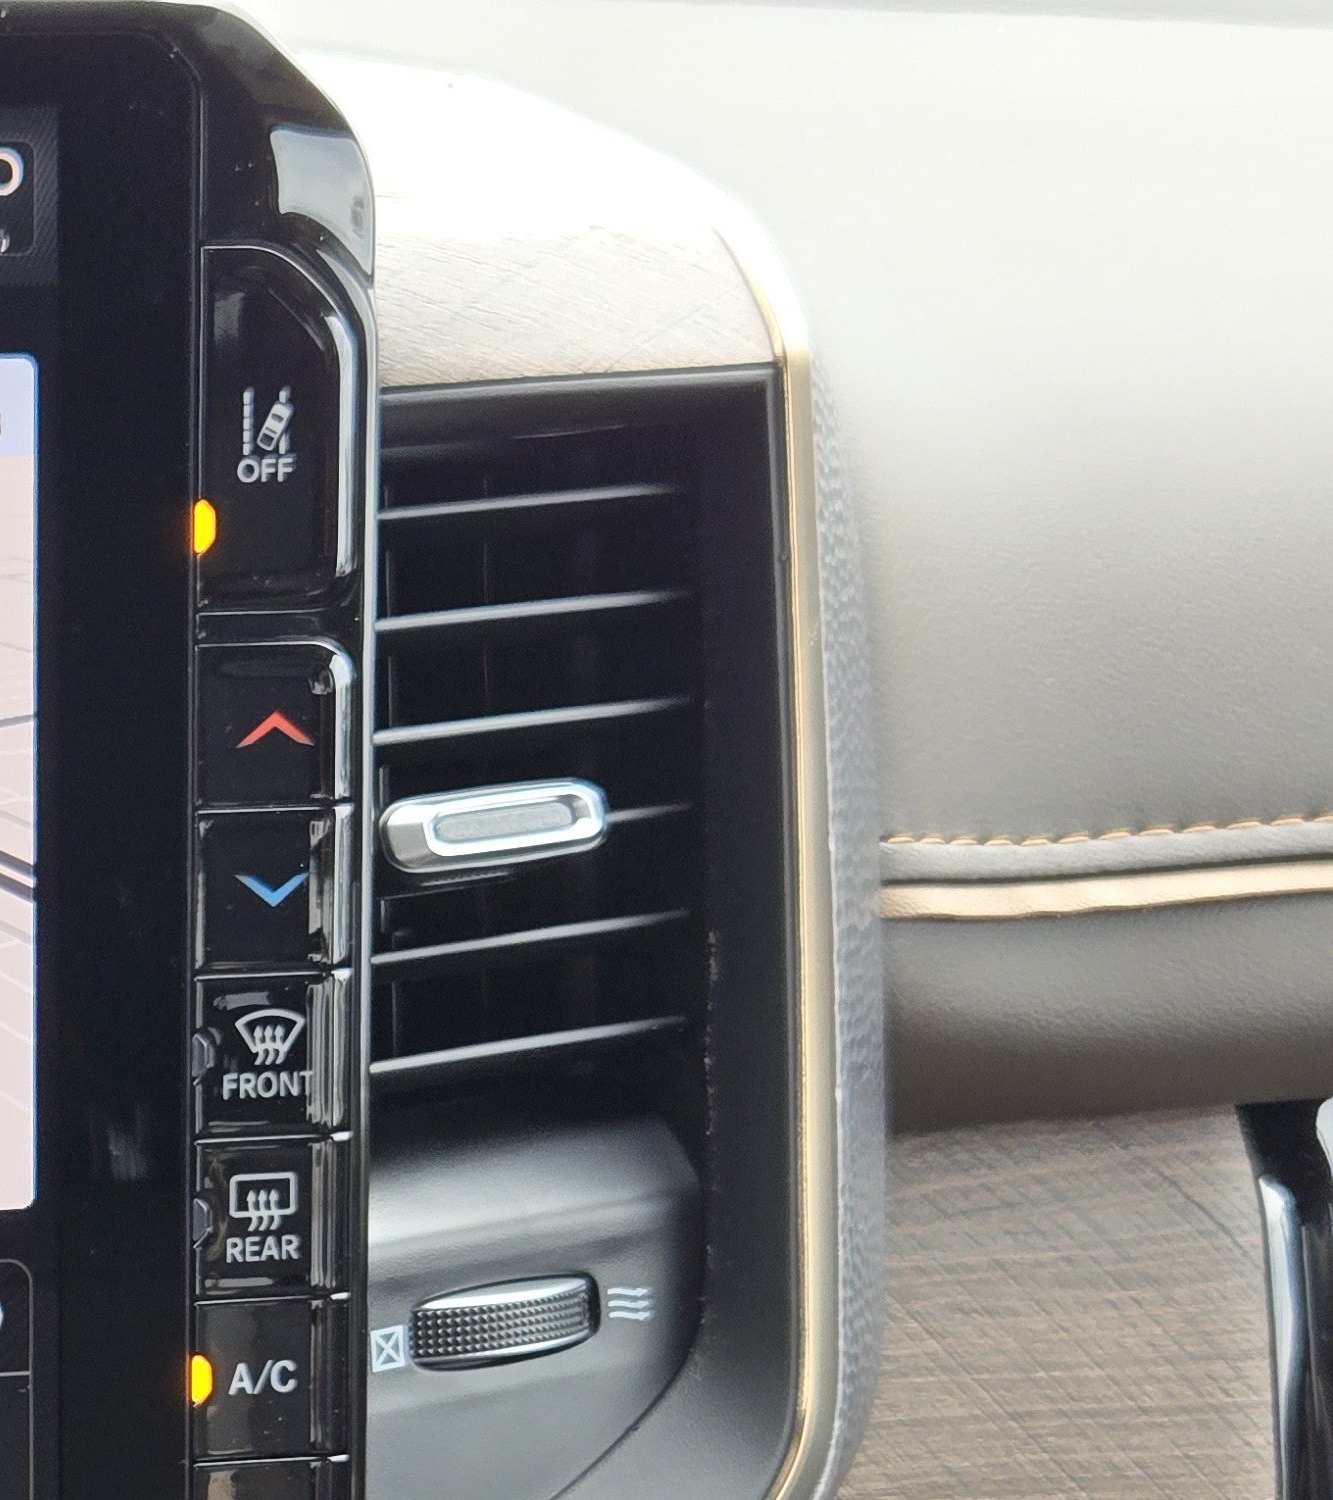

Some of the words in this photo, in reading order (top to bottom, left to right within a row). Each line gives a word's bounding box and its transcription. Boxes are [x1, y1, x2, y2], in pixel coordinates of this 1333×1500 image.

[236, 454, 297, 483] OFF
[222, 1070, 314, 1099] FRONT
[225, 1234, 300, 1263] REAR
[228, 1359, 298, 1396] A/C
